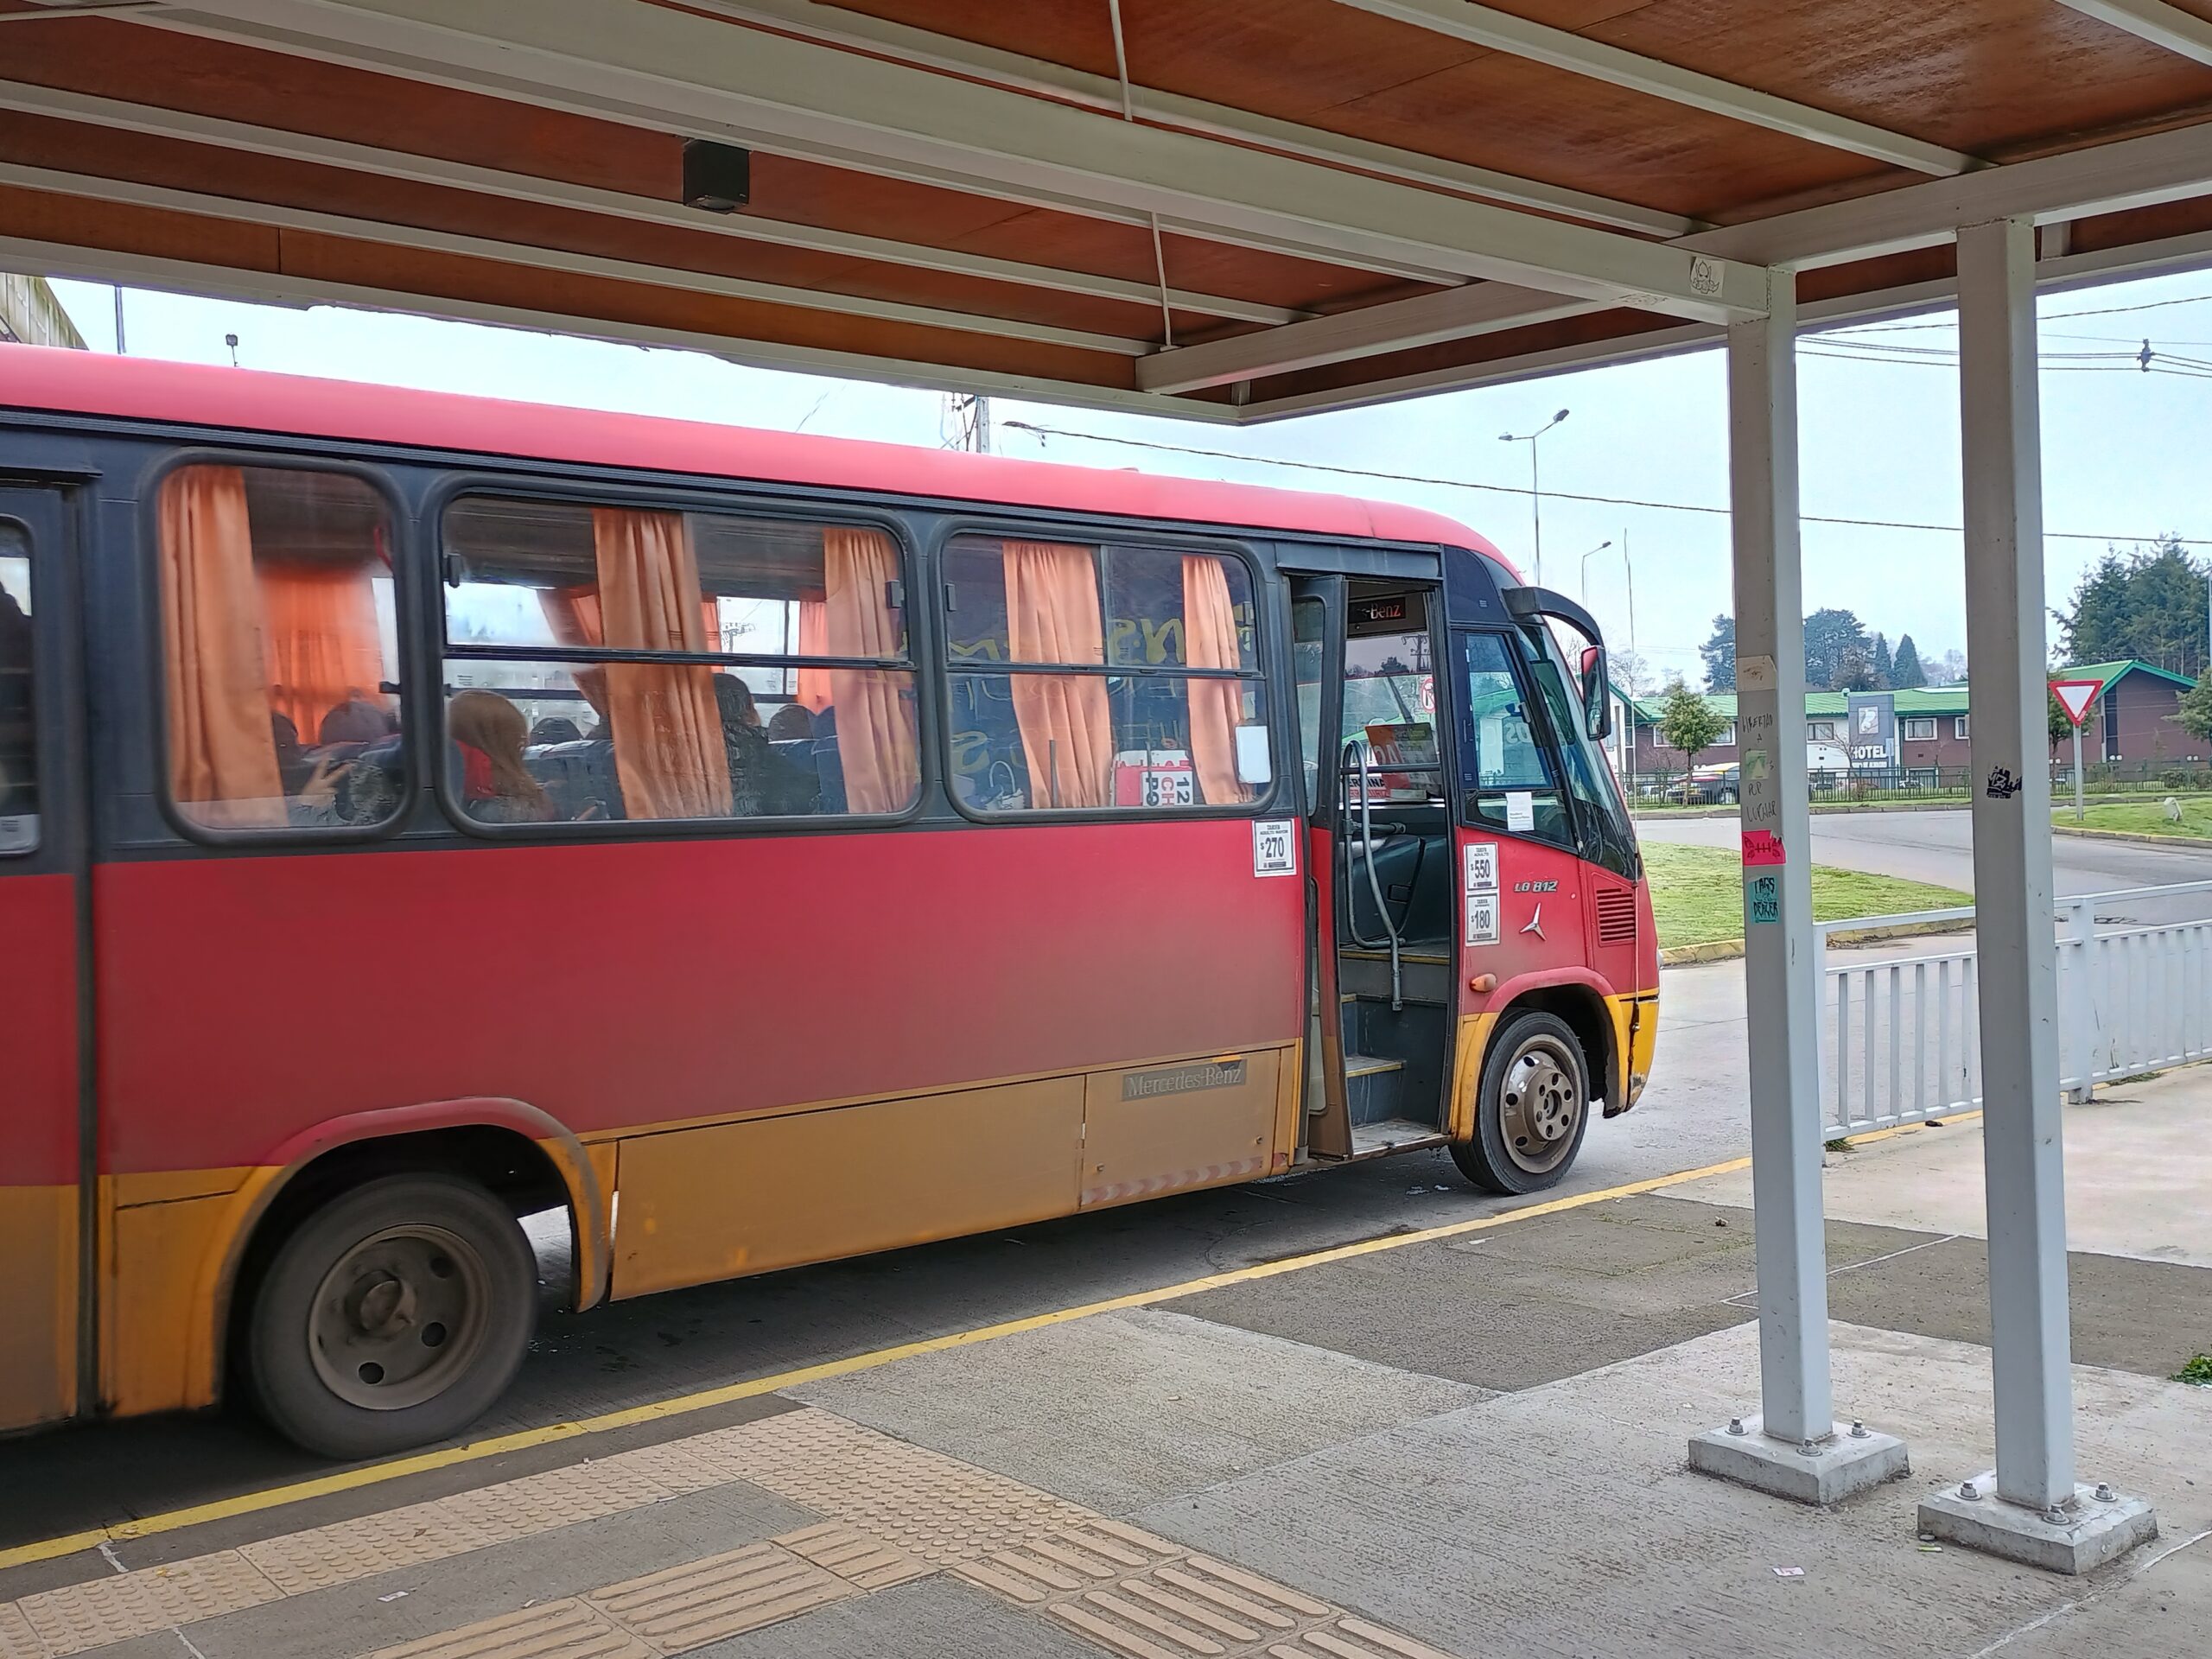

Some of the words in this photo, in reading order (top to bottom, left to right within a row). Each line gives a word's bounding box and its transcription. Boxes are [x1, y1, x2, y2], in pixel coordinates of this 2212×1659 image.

[1851, 745, 1887, 760] HOTEL
[1177, 777, 1190, 804] 12
[1260, 836, 1284, 858] $270
[1471, 859, 1491, 879] $550
[1532, 880, 1559, 893] 812
[1471, 910, 1491, 930] $180
[1128, 1065, 1243, 1097] Mercedes-Benz
